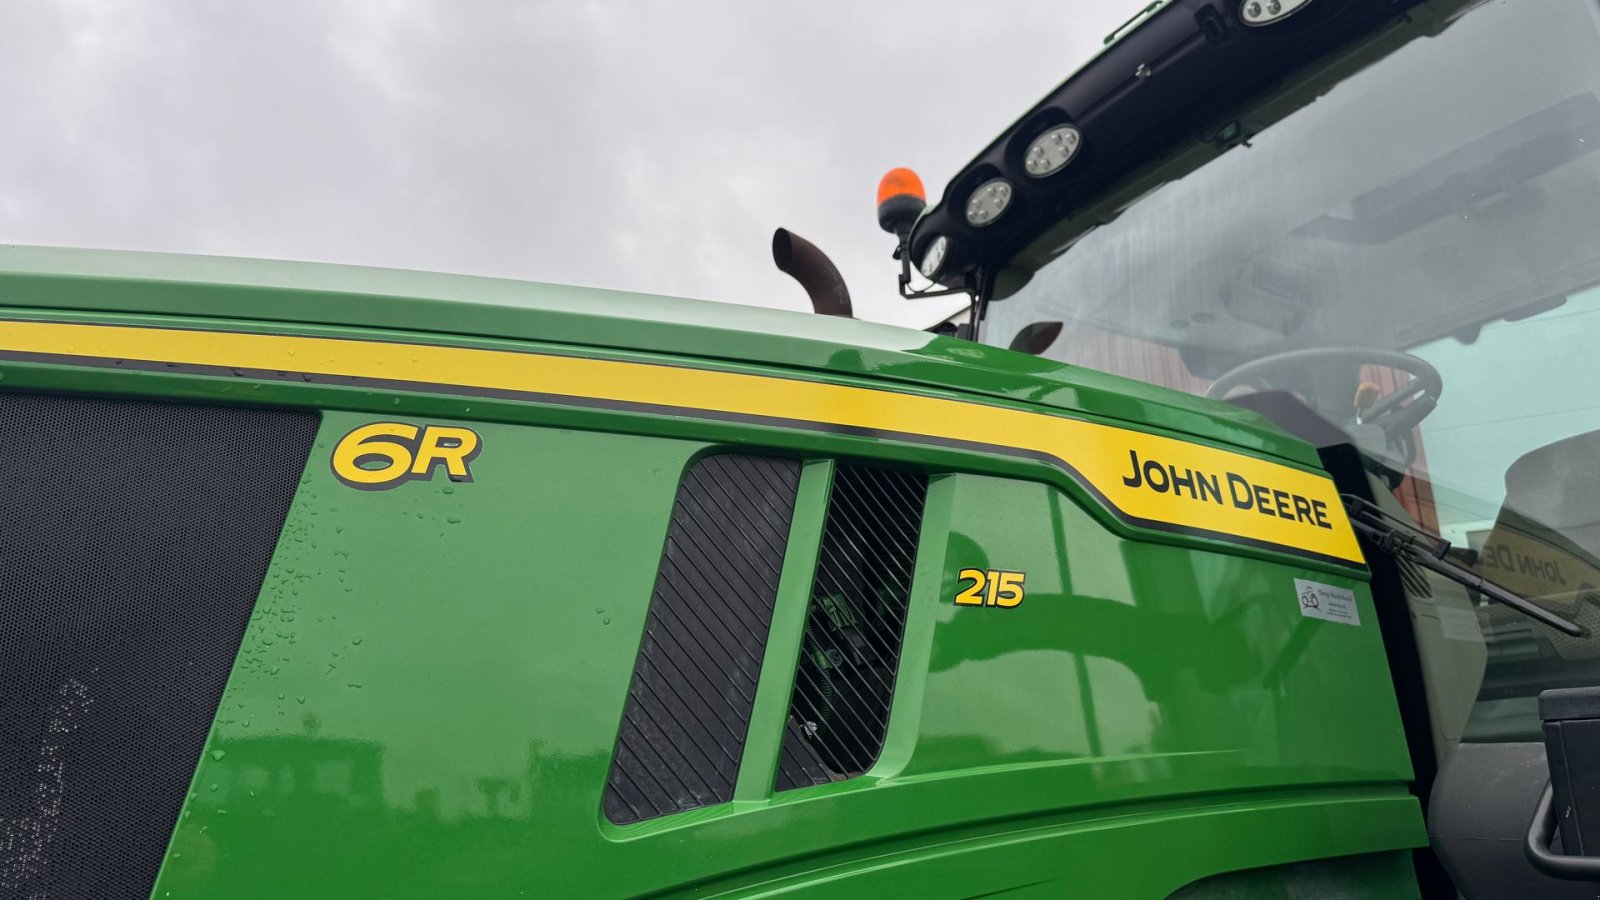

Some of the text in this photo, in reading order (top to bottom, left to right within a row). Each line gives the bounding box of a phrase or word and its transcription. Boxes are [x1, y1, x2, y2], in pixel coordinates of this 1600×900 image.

[330, 421, 484, 491] 6R
[1122, 450, 1333, 529] JOHN DEERE
[953, 567, 1026, 609] 215
